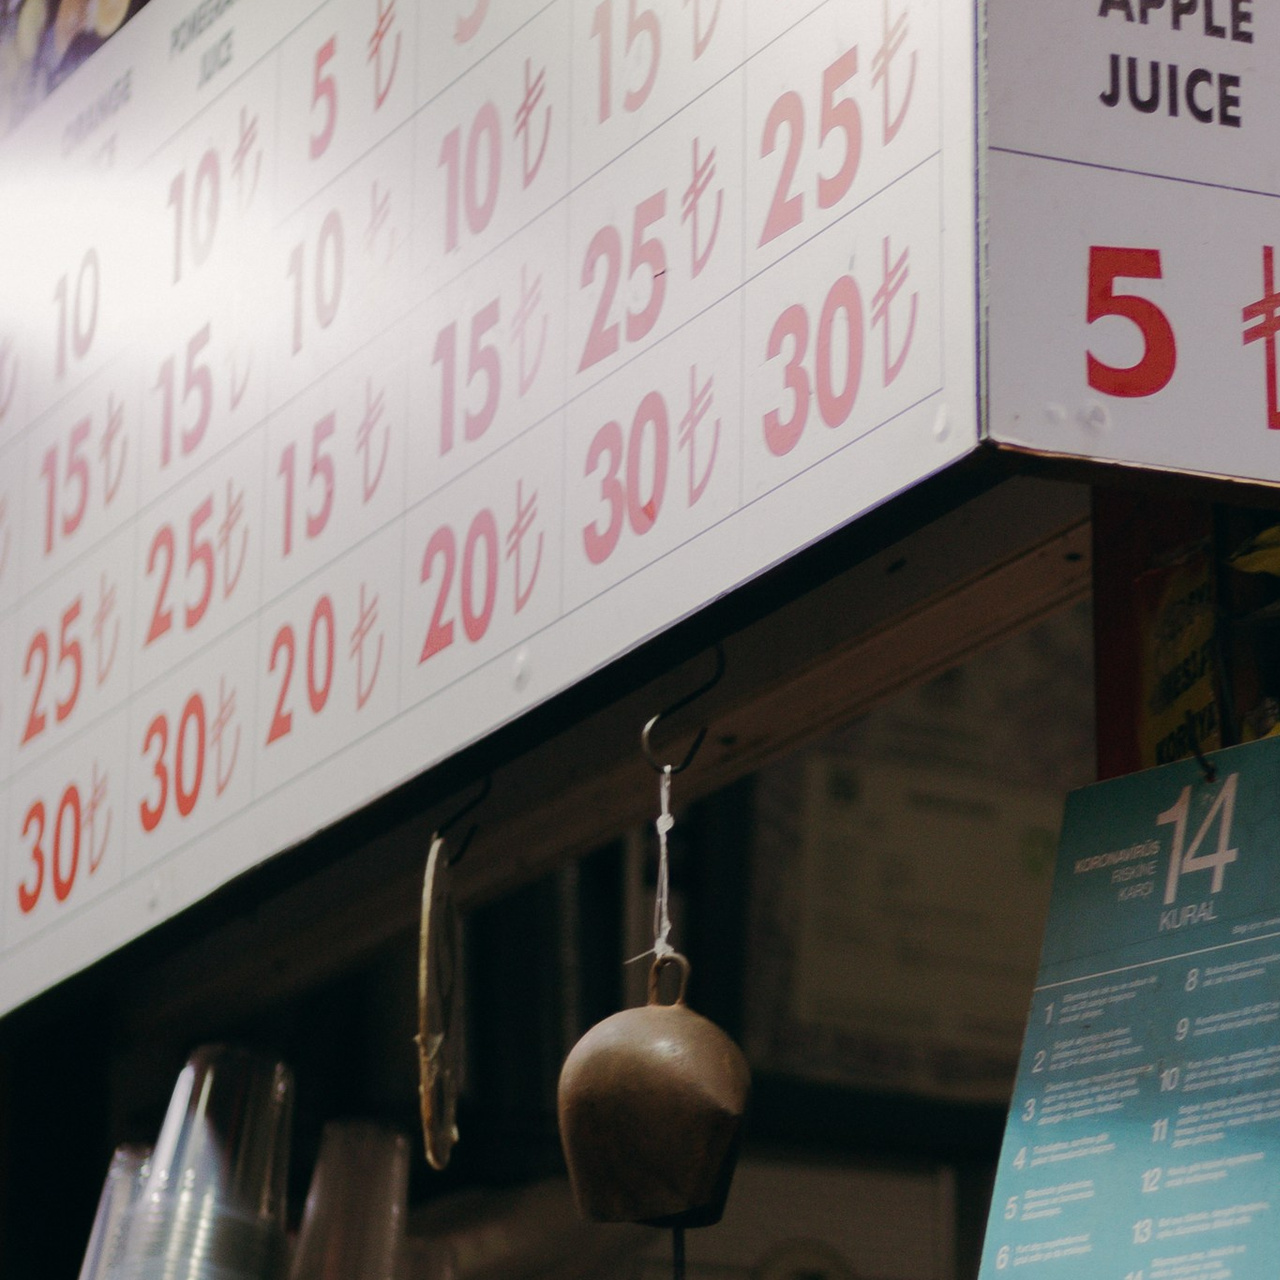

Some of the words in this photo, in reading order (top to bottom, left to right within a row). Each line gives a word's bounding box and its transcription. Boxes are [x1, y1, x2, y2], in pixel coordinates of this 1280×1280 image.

[309, 32, 338, 162] 5
[756, 45, 863, 250] 25
[1099, 53, 1242, 128] JUICE
[167, 149, 221, 285] 10
[438, 102, 500, 254] 10
[53, 247, 99, 383] 10
[287, 209, 345, 357] 10
[577, 188, 668, 374] 25
[1085, 245, 1178, 399] 5
[155, 322, 213, 468] 15
[431, 296, 501, 459] 15
[764, 274, 864, 457] 30
[40, 417, 92, 557] 15
[279, 410, 338, 558] 15
[581, 390, 670, 565] 30
[143, 494, 215, 649] 25
[418, 508, 498, 665] 20
[20, 597, 83, 748] 25
[266, 594, 336, 747] 20
[140, 693, 206, 833] 30
[18, 785, 82, 914] 30
[1156, 772, 1239, 905] 14
[1158, 900, 1219, 932] KURAL
[1184, 968, 1199, 992] 8
[1033, 1049, 1046, 1073] 2
[1044, 1002, 1055, 1025] 1
[1160, 1067, 1180, 1092] 10
[1175, 1018, 1190, 1041] 9
[1013, 1146, 1027, 1171] 4
[1022, 1098, 1036, 1122] 3
[1151, 1117, 1169, 1143] 11
[1004, 1195, 1018, 1220] 5
[1132, 1218, 1153, 1245] 13
[1141, 1167, 1162, 1193] 12
[995, 1245, 1009, 1270] 6
